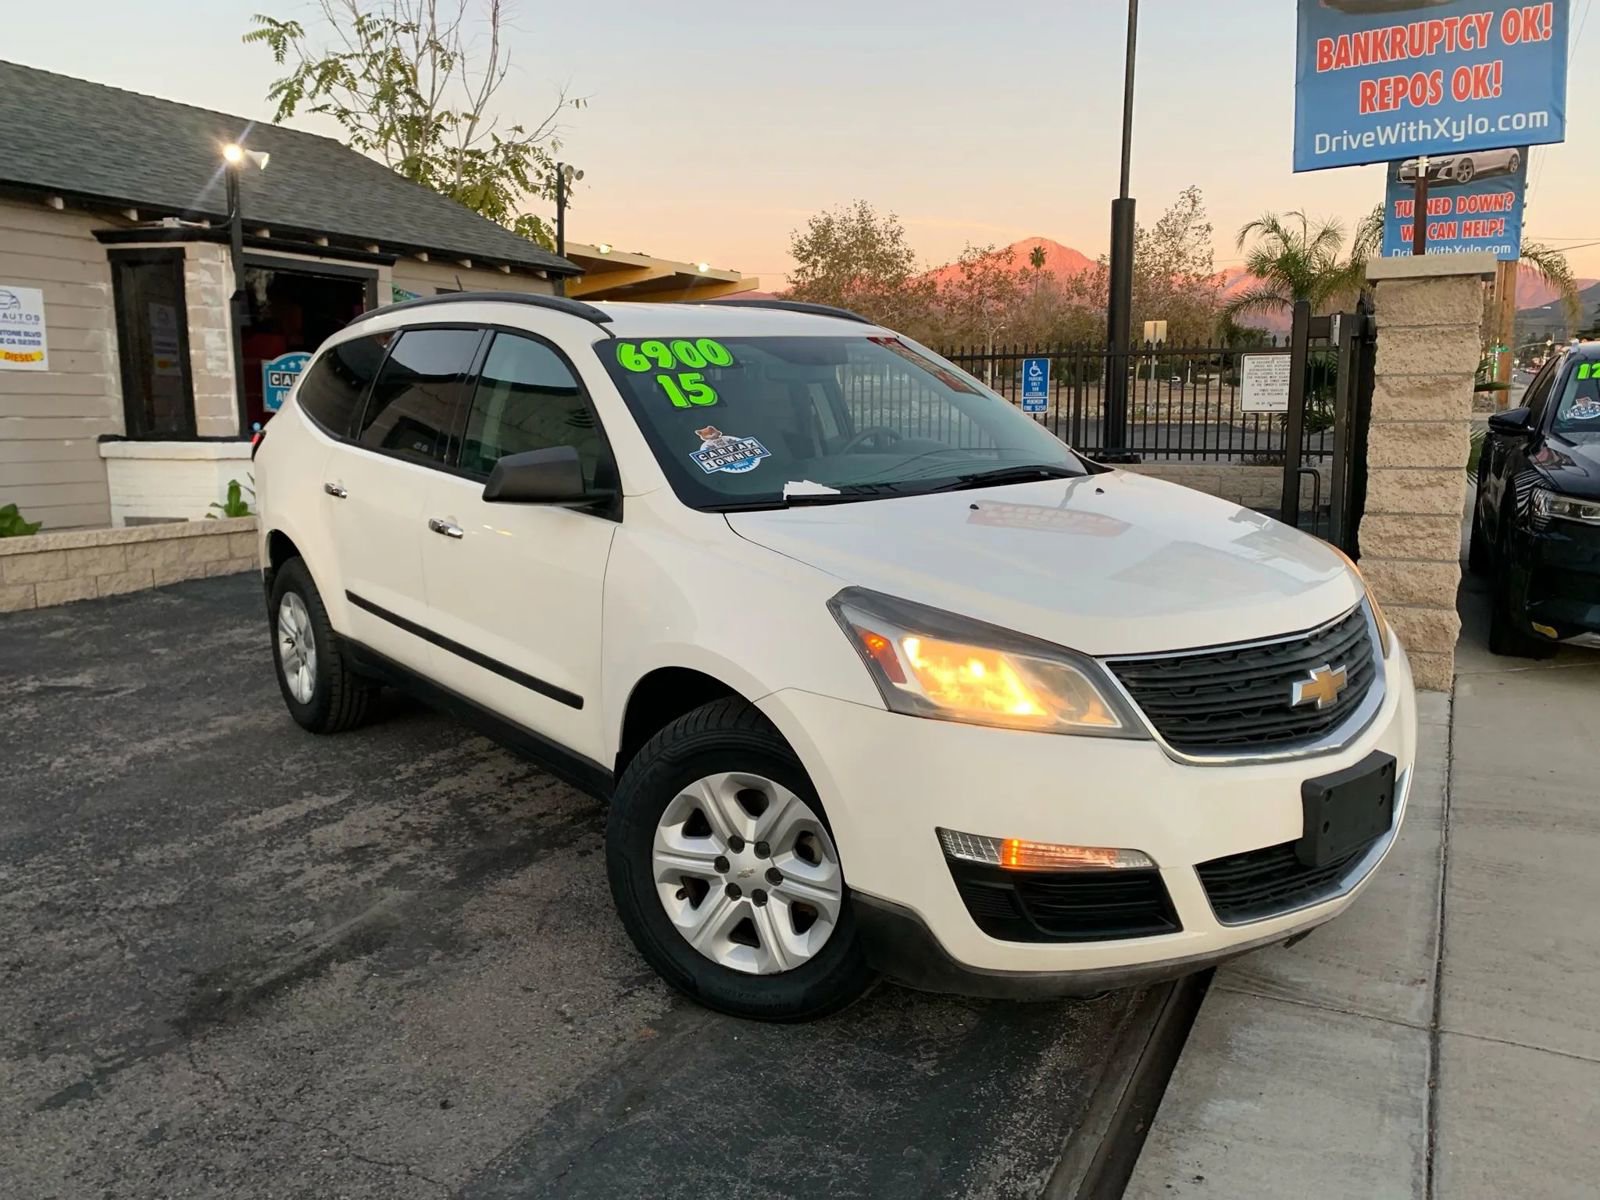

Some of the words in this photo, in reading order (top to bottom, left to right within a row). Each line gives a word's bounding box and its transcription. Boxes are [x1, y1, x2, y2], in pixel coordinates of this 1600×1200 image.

[1316, 12, 1494, 73] BANKRUPTCY
[1500, 2, 1553, 45] OK!
[1359, 70, 1444, 115] REPOS
[1451, 60, 1504, 103] OK!
[1314, 110, 1549, 155] DriveWithXylo.com
[1395, 197, 1452, 219] TUNED
[1456, 191, 1515, 214] DOWN?
[1401, 224, 1415, 243] W
[1427, 222, 1458, 241] CAN
[1461, 217, 1505, 239] HELP!
[5, 352, 34, 362] DIESEL
[616, 338, 734, 372] 6900
[656, 372, 718, 408] 15
[698, 441, 757, 461] CARFAX
[716, 448, 763, 466] OWNER
